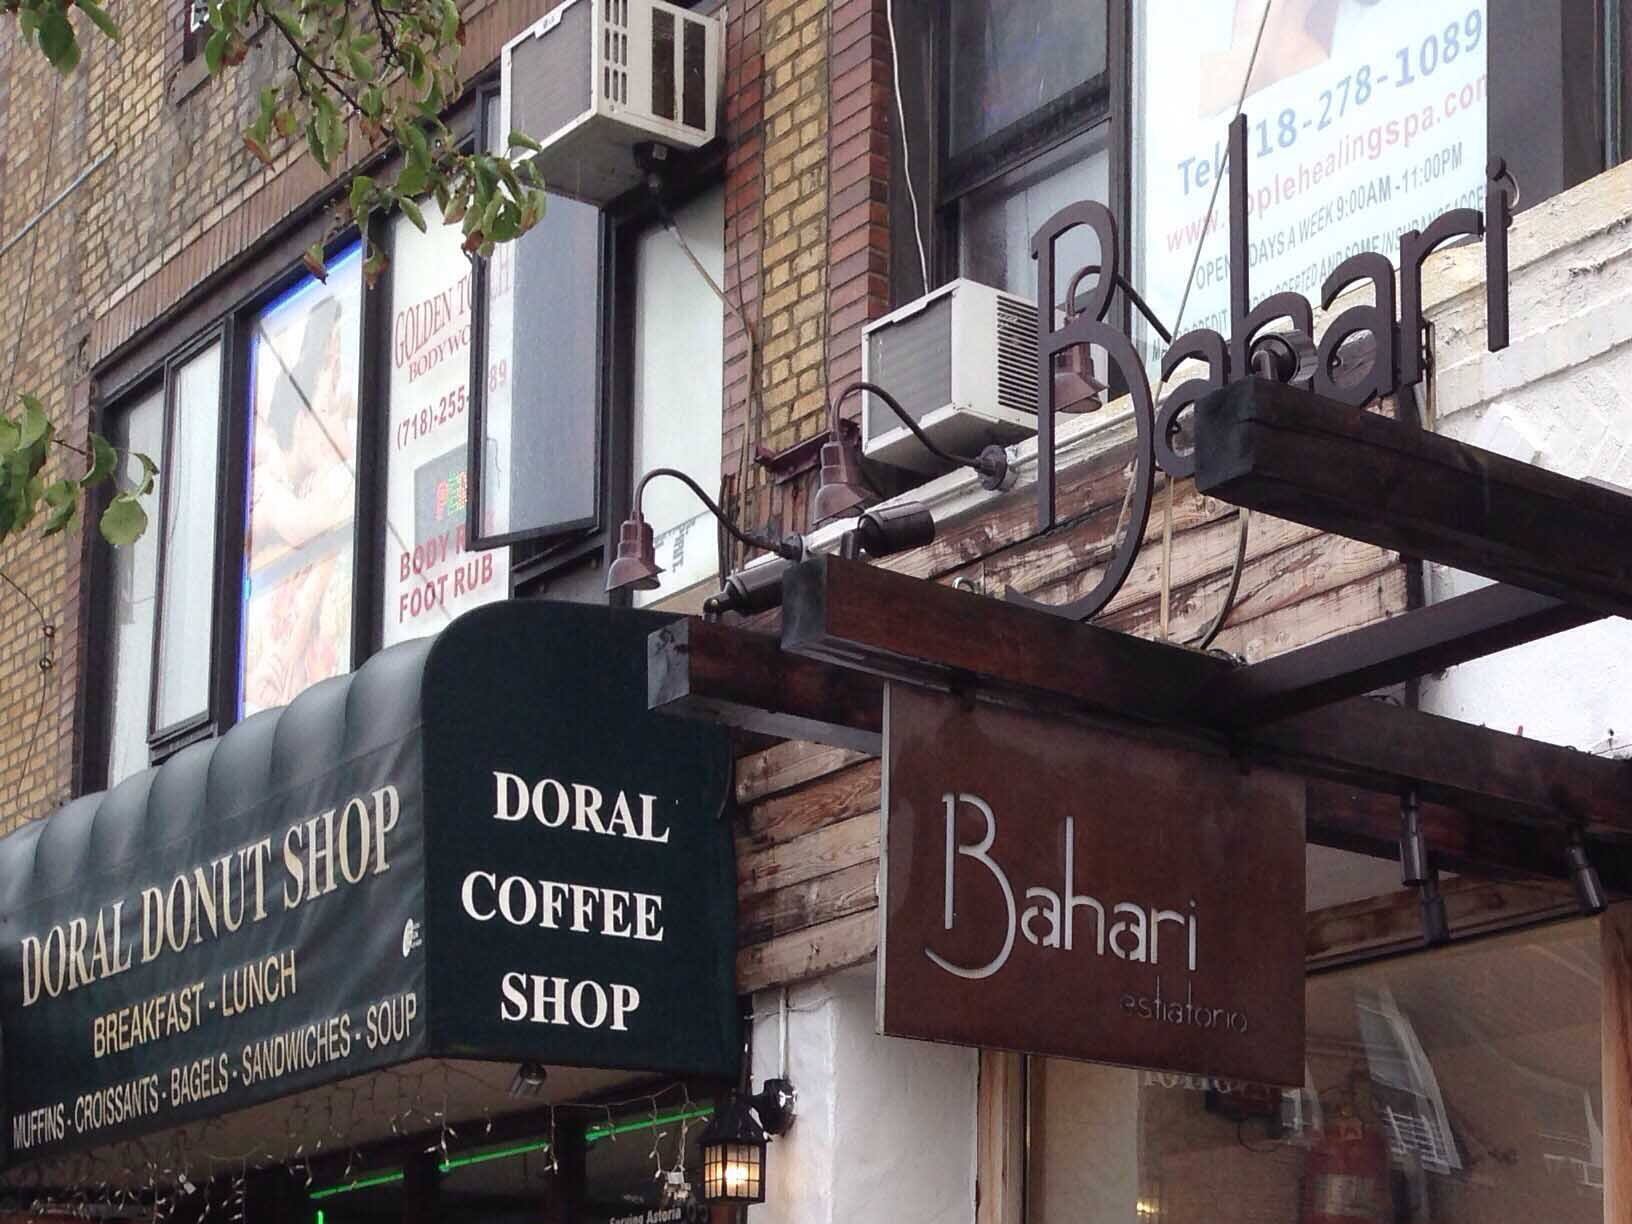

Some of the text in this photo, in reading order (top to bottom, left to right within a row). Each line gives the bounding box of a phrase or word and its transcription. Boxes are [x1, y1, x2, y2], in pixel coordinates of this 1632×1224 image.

[1238, 8, 1484, 160] 18-278-1089
[1298, 203, 1333, 244] WEEK
[1335, 175, 1392, 221] 9:00AM
[394, 286, 453, 369] GOLDEN
[1004, 113, 1511, 622] Bahari
[399, 552, 494, 624] FOOT RUB
[400, 532, 449, 584] BODY
[492, 770, 670, 844] DORAL
[20, 784, 401, 1007] DORAL DONUT SHOP
[461, 870, 665, 942] COFFEE
[924, 792, 1198, 980] Bahari
[93, 982, 205, 1059] BREAKFAST
[222, 949, 296, 1017] LUNCH
[500, 971, 641, 1032] SHOP
[13, 1103, 64, 1151] MUFFINS
[74, 1073, 159, 1134] CROISSANTS
[170, 1051, 229, 1107] BAGELS
[242, 1012, 351, 1087] SANDWICHES
[366, 992, 418, 1051] SOUP
[646, 1206, 682, 1224] Astoria
